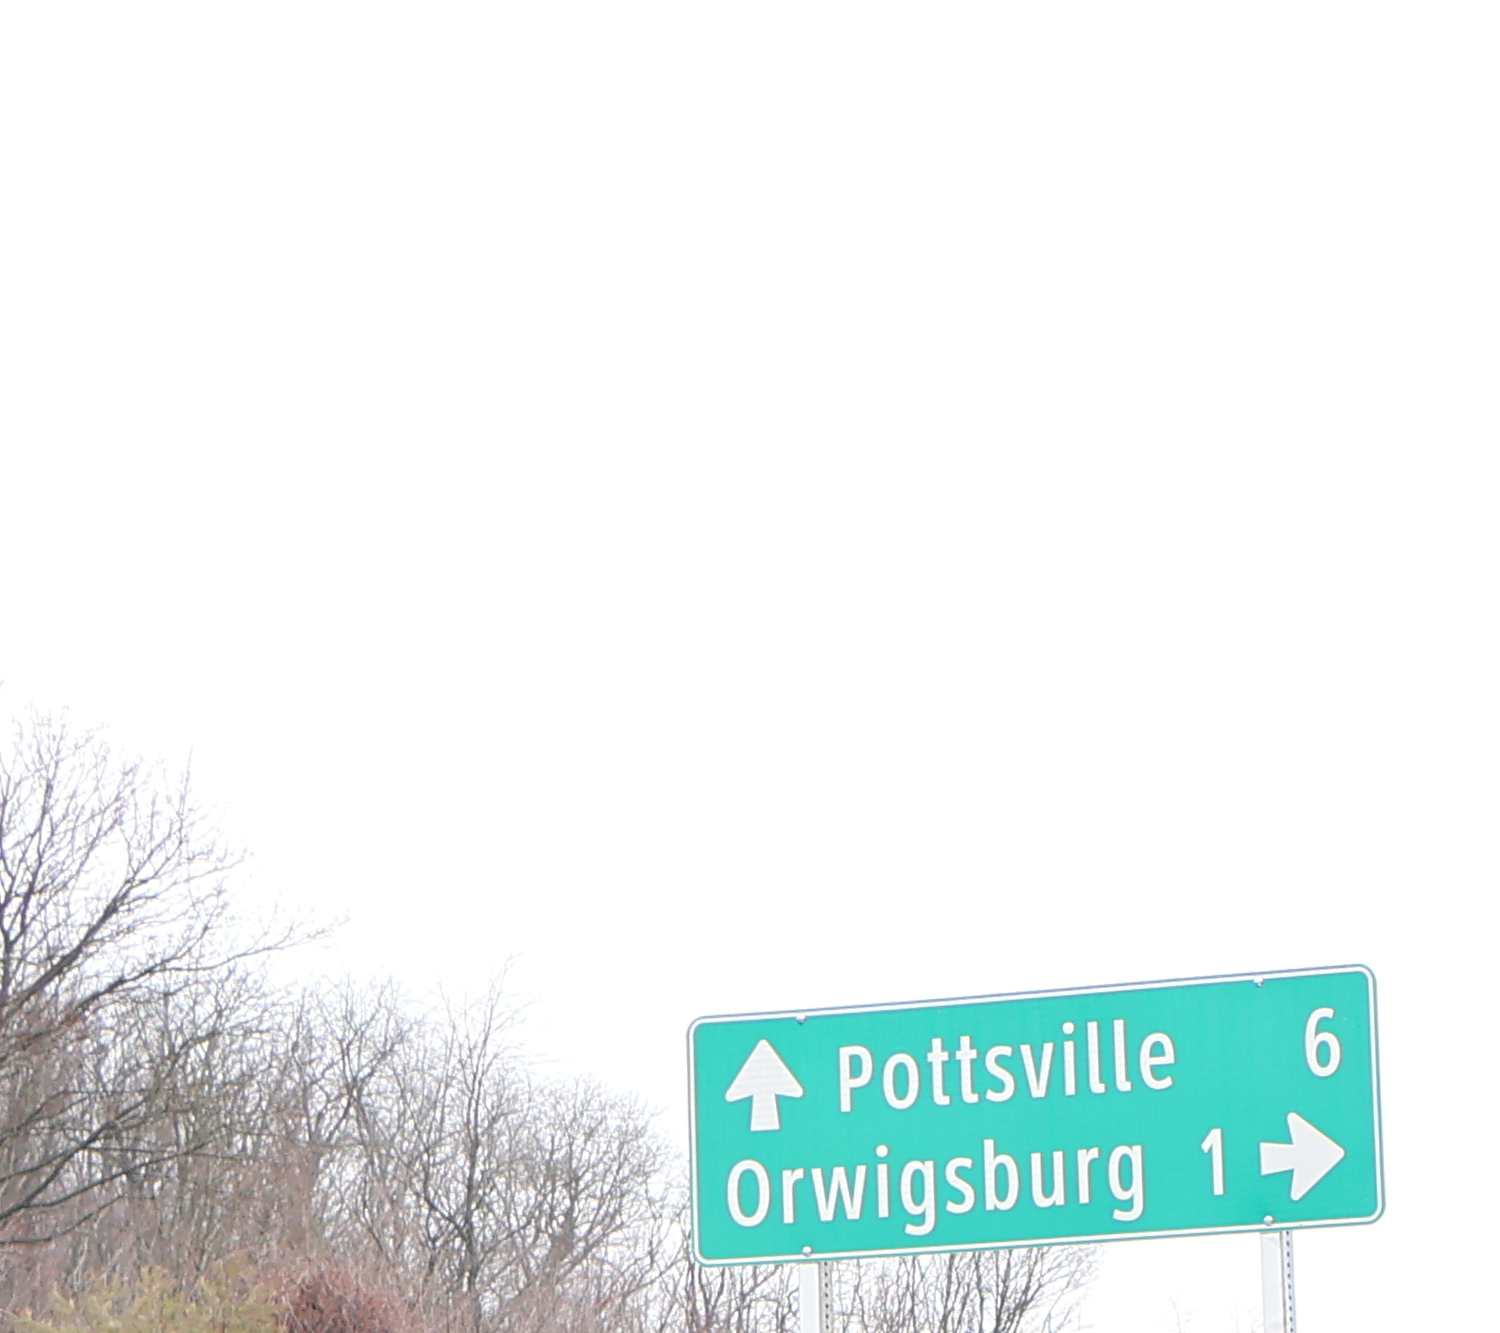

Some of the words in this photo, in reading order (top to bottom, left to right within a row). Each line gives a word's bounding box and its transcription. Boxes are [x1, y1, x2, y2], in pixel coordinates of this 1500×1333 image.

[838, 1017, 1176, 1112] Pottsville
[1304, 1006, 1343, 1078] 6
[725, 1137, 1146, 1236] Orwigsburg
[1200, 1127, 1226, 1196] 1
